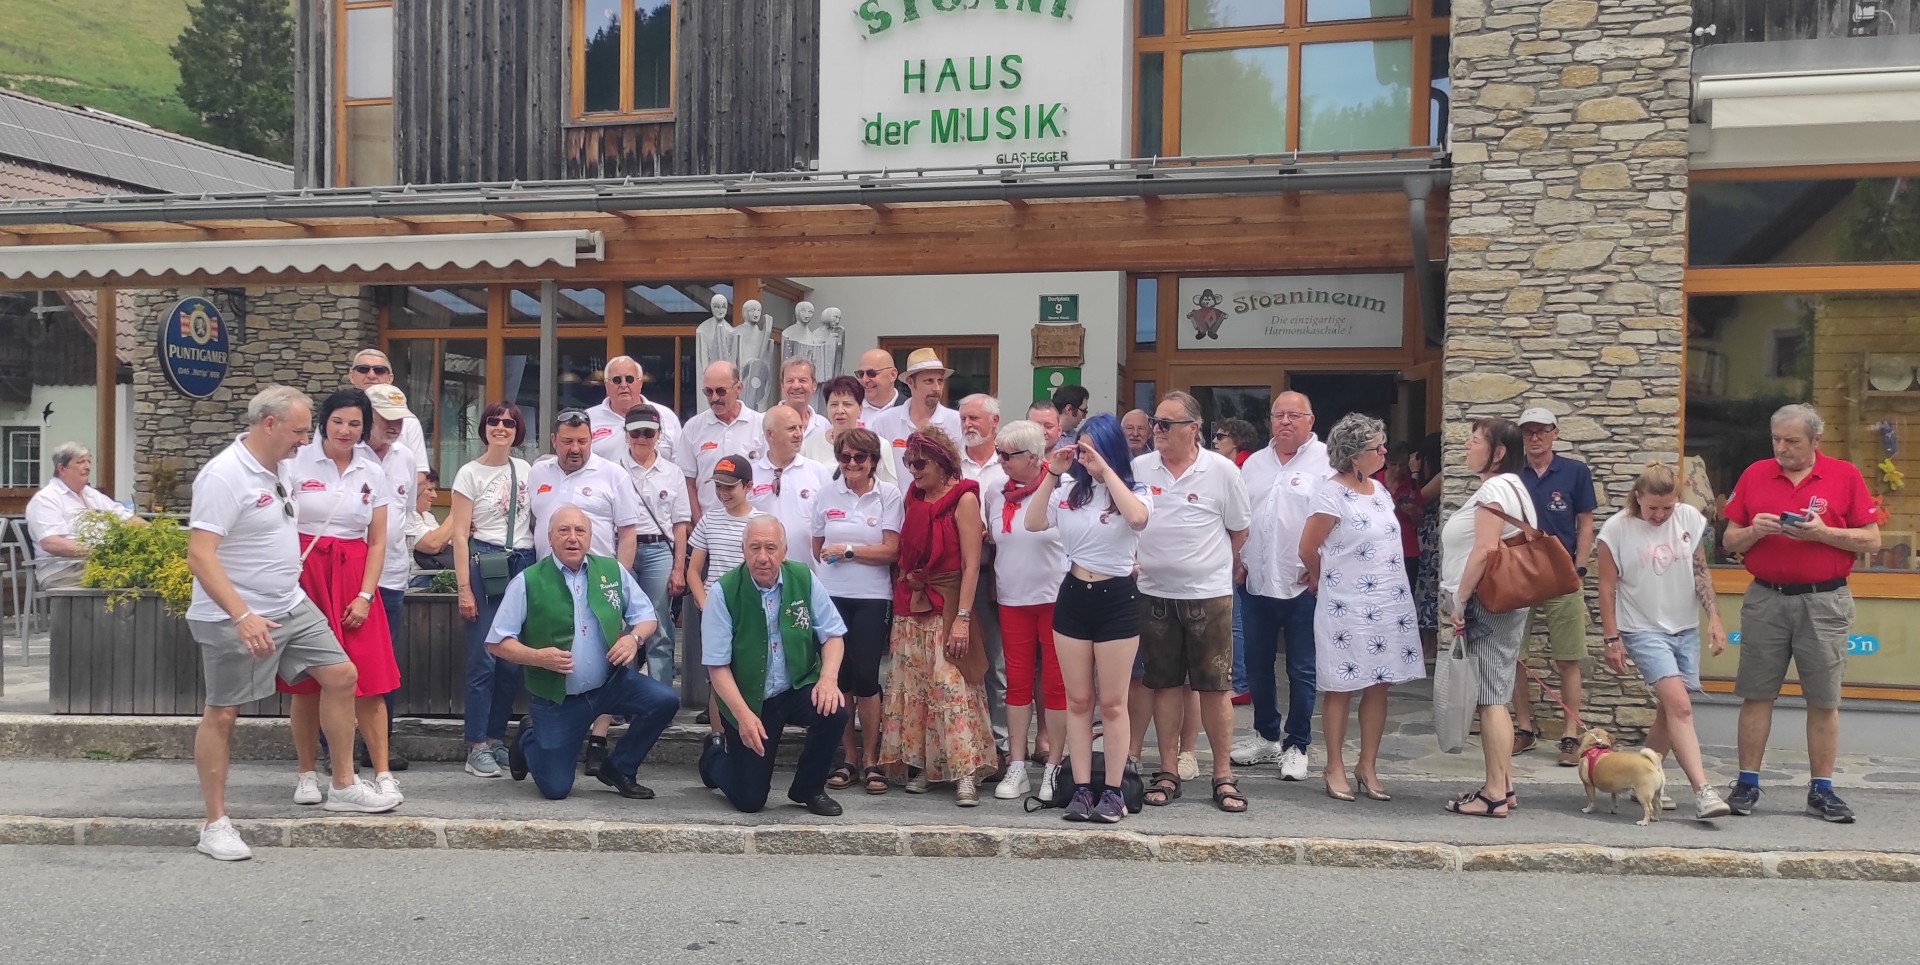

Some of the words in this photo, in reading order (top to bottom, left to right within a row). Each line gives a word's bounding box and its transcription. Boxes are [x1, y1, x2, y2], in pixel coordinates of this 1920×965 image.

[903, 54, 1023, 94] HAUS
[864, 112, 921, 146] der
[930, 102, 1063, 144] MUSIK
[1055, 303, 1063, 314] 9
[1232, 287, 1387, 315] Stoanineum
[1263, 325, 1346, 336] Harmonikaschule
[1271, 315, 1288, 325] Die
[1289, 314, 1346, 327] einzigartige
[168, 344, 228, 364] PUNTIGAMER
